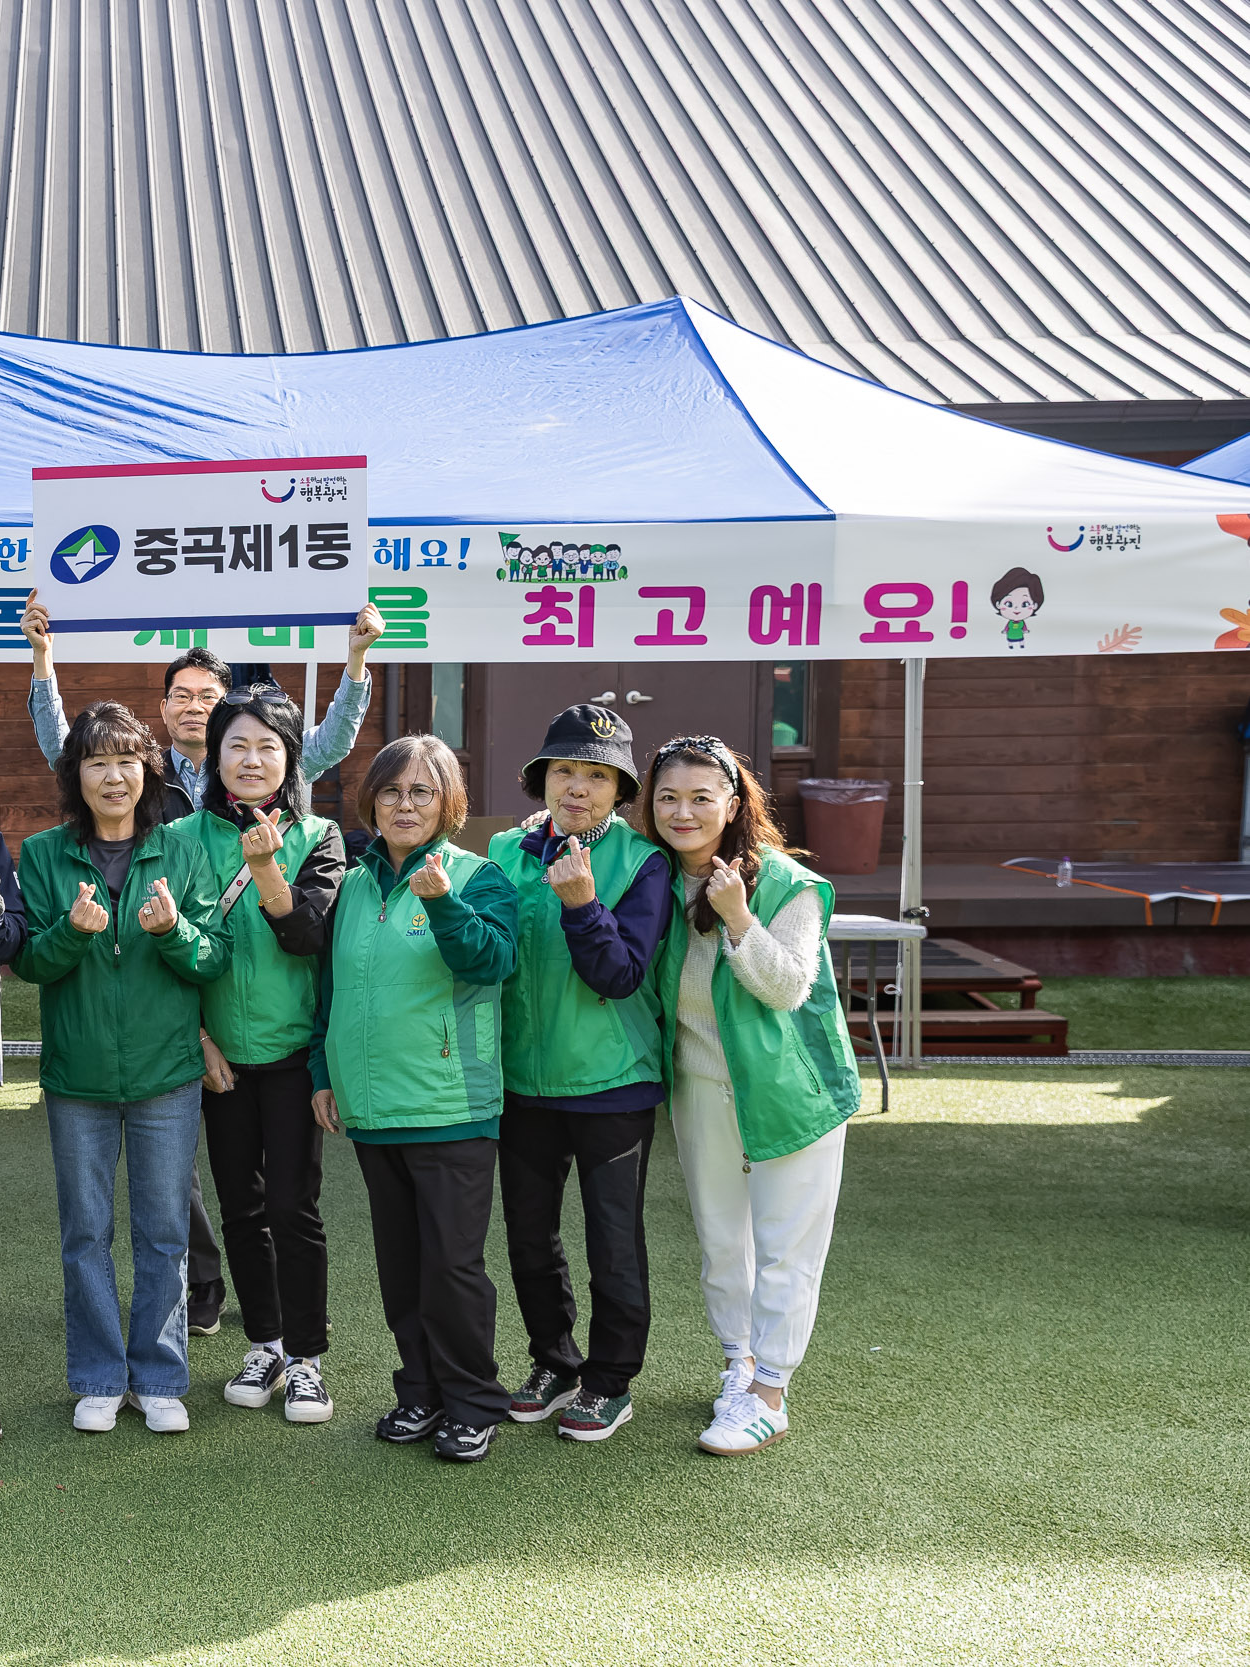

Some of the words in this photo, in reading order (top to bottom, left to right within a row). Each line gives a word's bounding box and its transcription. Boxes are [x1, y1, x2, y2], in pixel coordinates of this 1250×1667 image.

[300, 485, 347, 502] 행복광진
[134, 522, 351, 576] 중곡제1동
[1089, 533, 1141, 551] 행복광진
[406, 929, 426, 937] SMU
